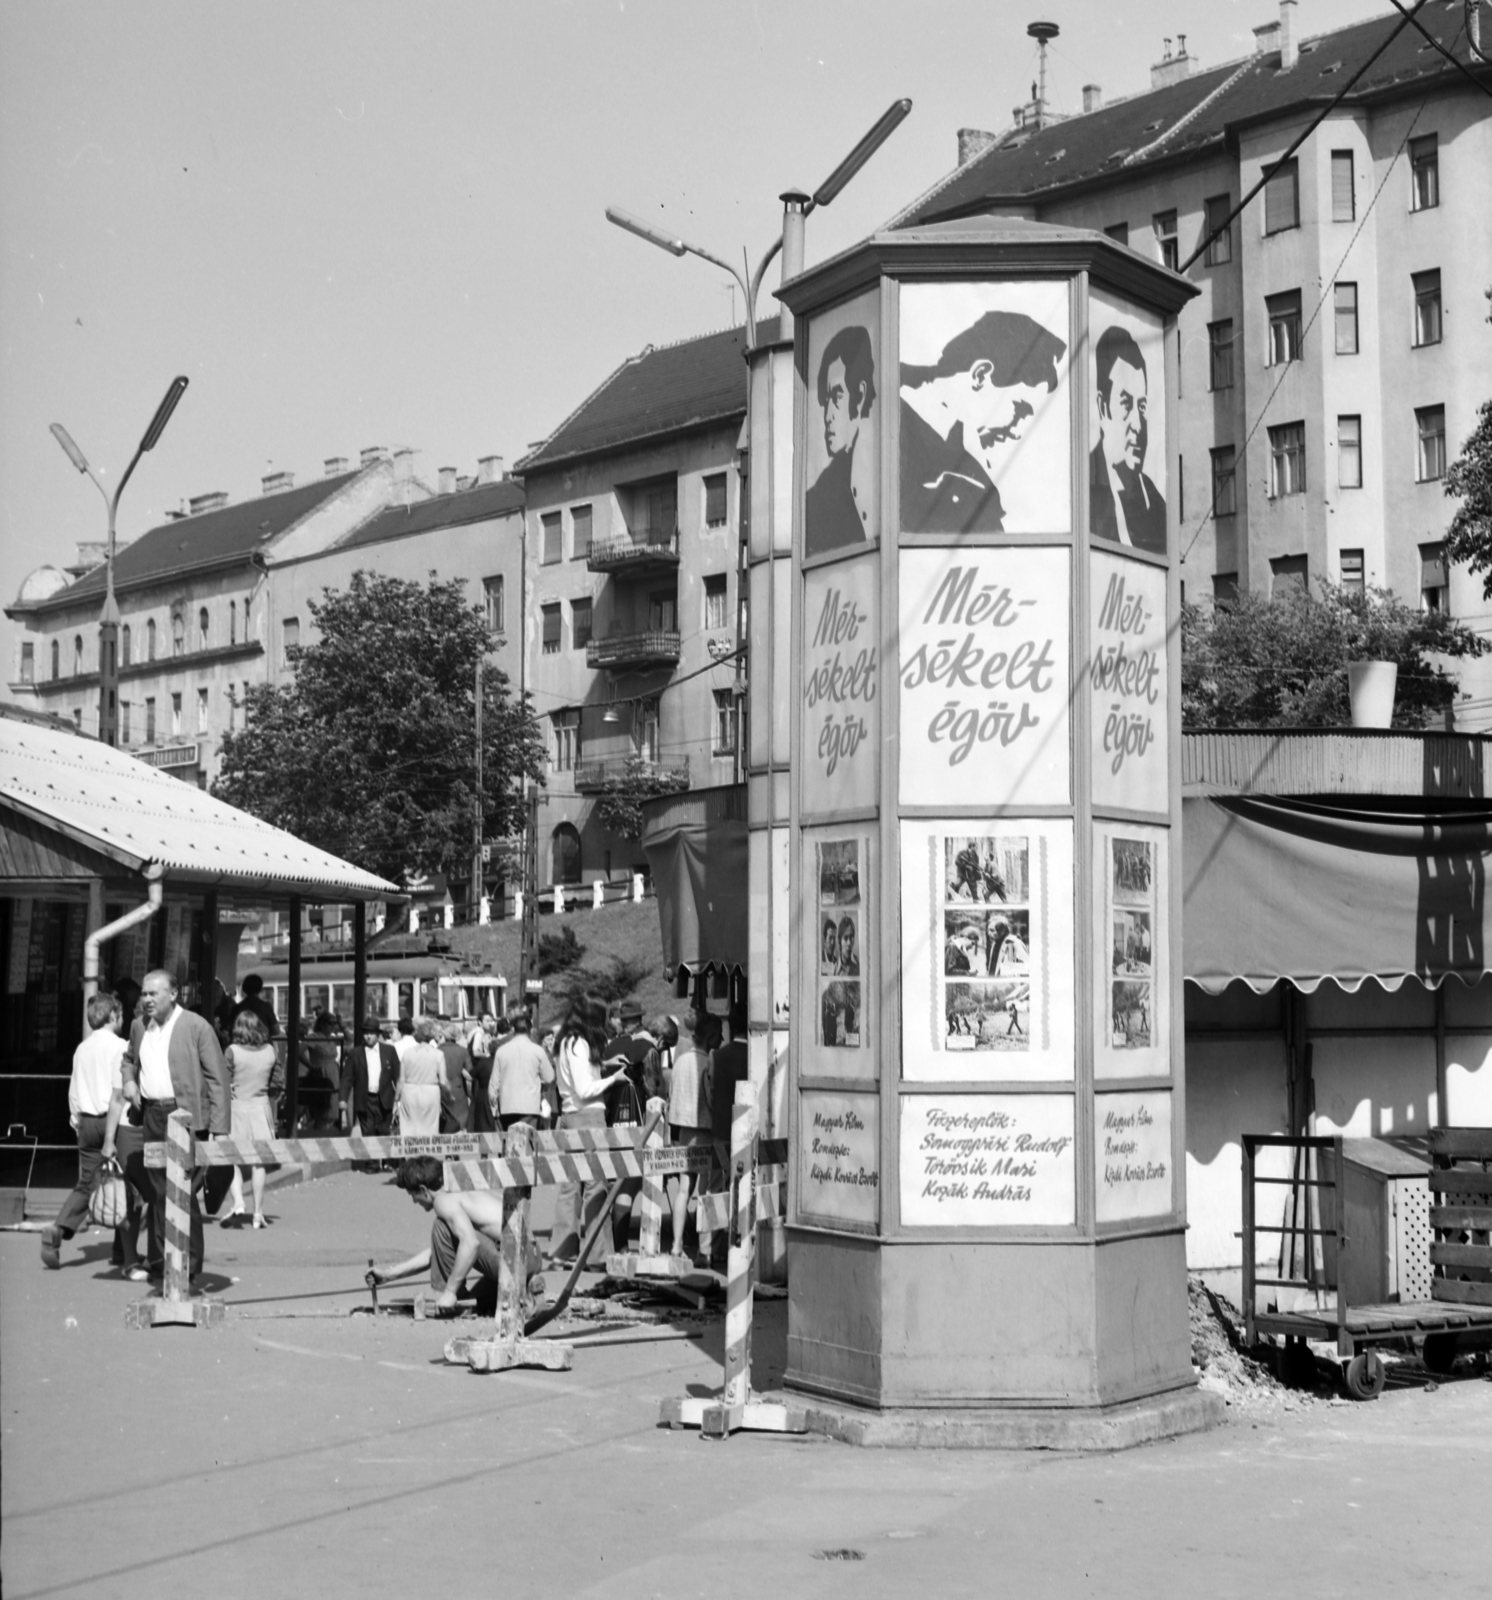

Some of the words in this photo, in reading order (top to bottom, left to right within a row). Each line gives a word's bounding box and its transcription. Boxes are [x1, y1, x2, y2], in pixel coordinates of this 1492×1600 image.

[811, 588, 867, 648] Mér-
[923, 565, 1038, 628] Mér-
[1098, 572, 1153, 636] Mér-
[804, 645, 877, 709] sékelt
[899, 632, 1055, 694] sékelt
[1090, 641, 1160, 706] sékelt
[817, 714, 868, 778] égöv
[927, 700, 1040, 768] égöv
[1103, 703, 1154, 776] égöv
[812, 1111, 845, 1134] Magyar
[918, 1132, 1011, 1159] Somogyvári
[1013, 1132, 1074, 1159] Rudolf
[1102, 1110, 1136, 1135] Magyar
[921, 1179, 969, 1203] Kozák
[971, 1180, 1032, 1202] András
[990, 1156, 1037, 1178] Mari
